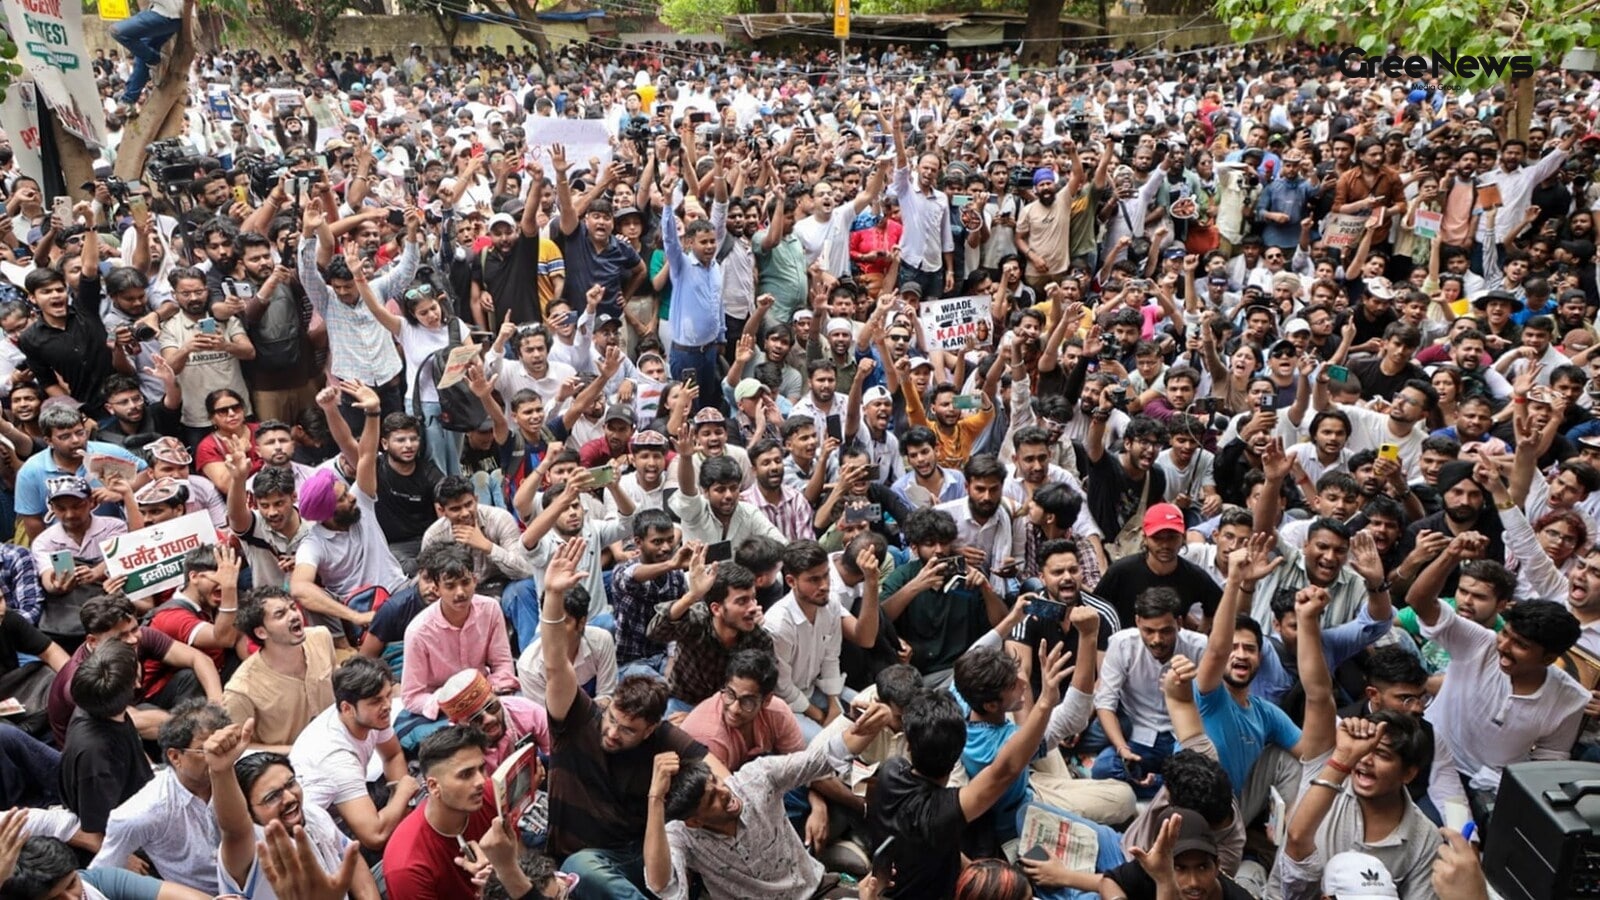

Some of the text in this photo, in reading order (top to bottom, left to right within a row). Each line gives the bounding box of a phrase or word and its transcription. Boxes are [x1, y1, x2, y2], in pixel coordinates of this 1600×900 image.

[940, 299, 972, 314] WAADE
[935, 311, 959, 322] BAHOT
[936, 322, 975, 341] KAAM
[158, 533, 200, 558] प्रधान
